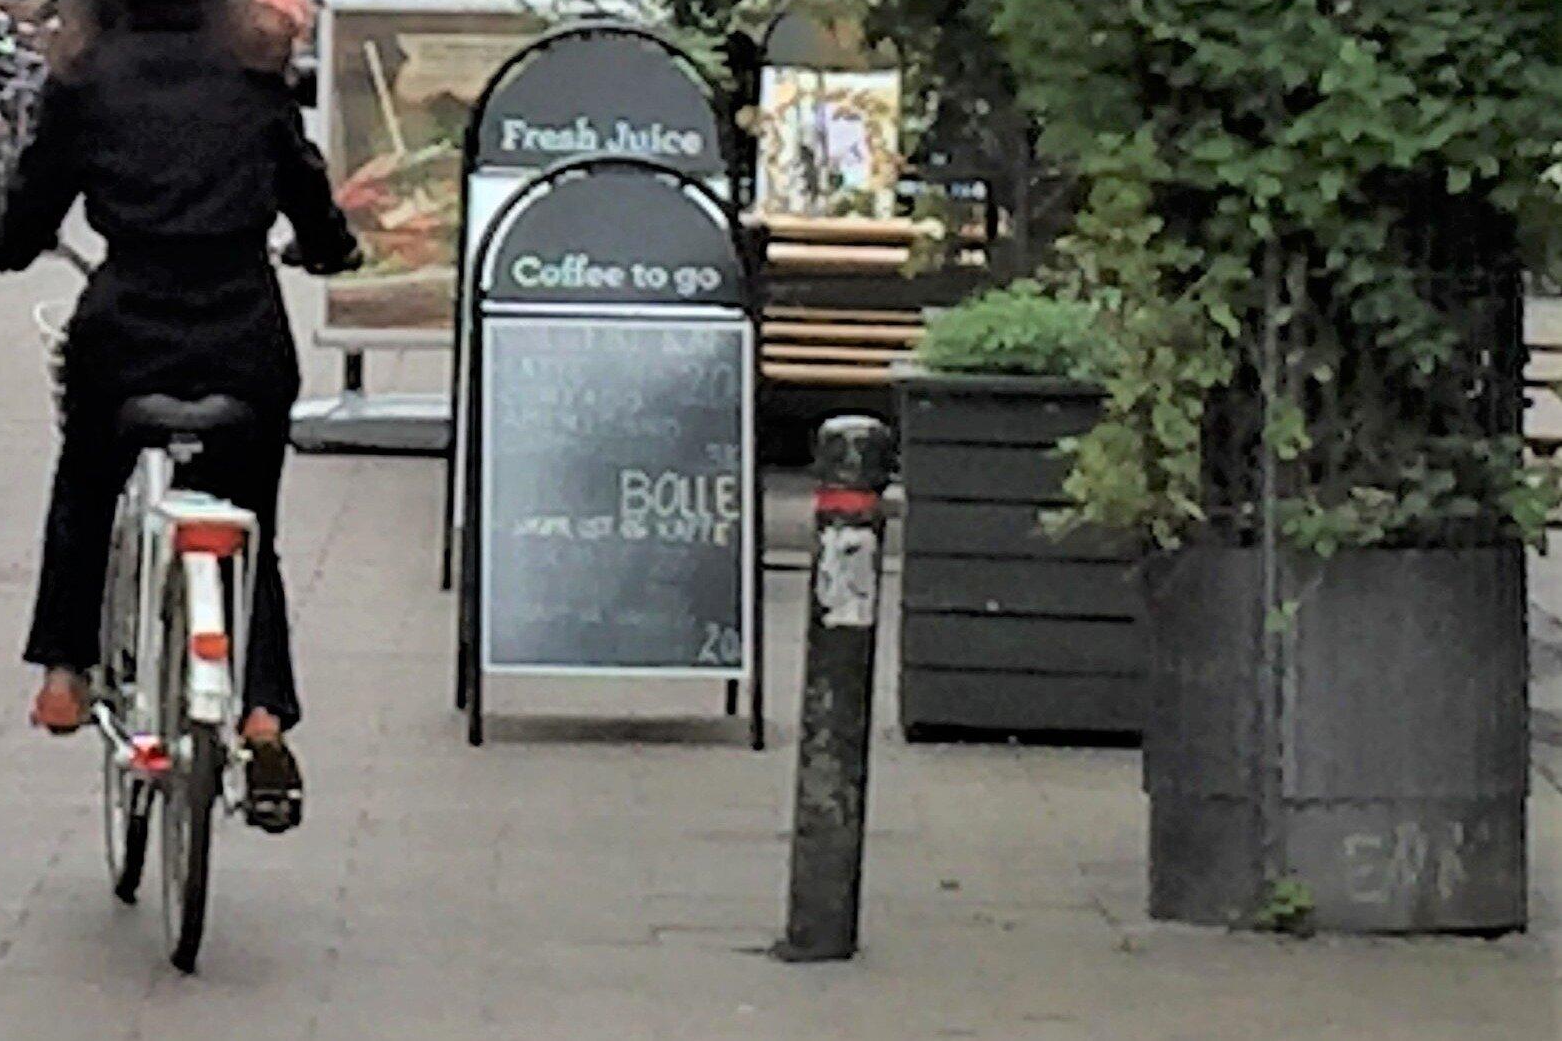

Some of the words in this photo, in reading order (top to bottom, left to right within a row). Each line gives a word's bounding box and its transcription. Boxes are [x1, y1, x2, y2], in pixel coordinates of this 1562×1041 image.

[500, 116, 598, 152] Fresh
[604, 120, 704, 155] Juice
[511, 254, 626, 288] Coffee
[631, 262, 670, 289] to
[673, 266, 723, 296] go
